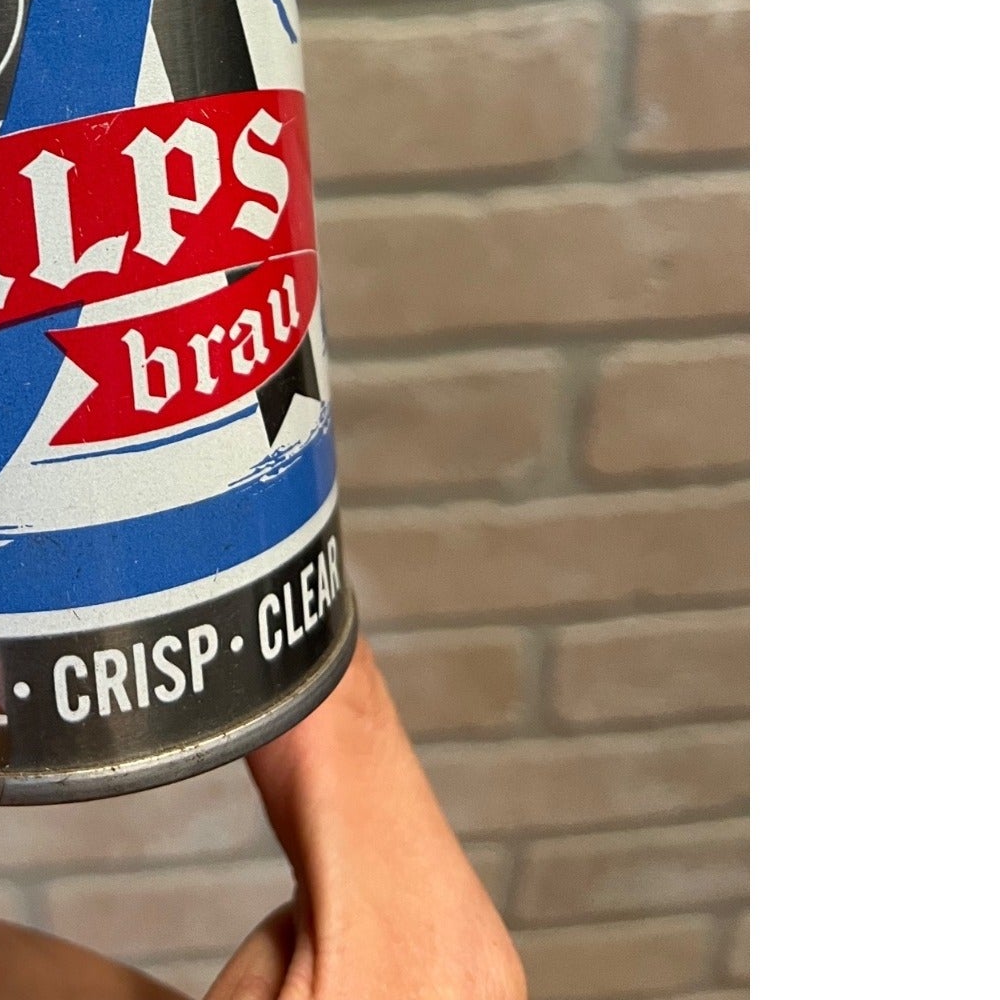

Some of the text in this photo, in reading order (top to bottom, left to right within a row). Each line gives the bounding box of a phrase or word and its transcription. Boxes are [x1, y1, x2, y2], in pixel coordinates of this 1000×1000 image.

[120, 273, 301, 415] brau
[53, 623, 219, 723] CRISP
[258, 534, 341, 661] CLEAR
